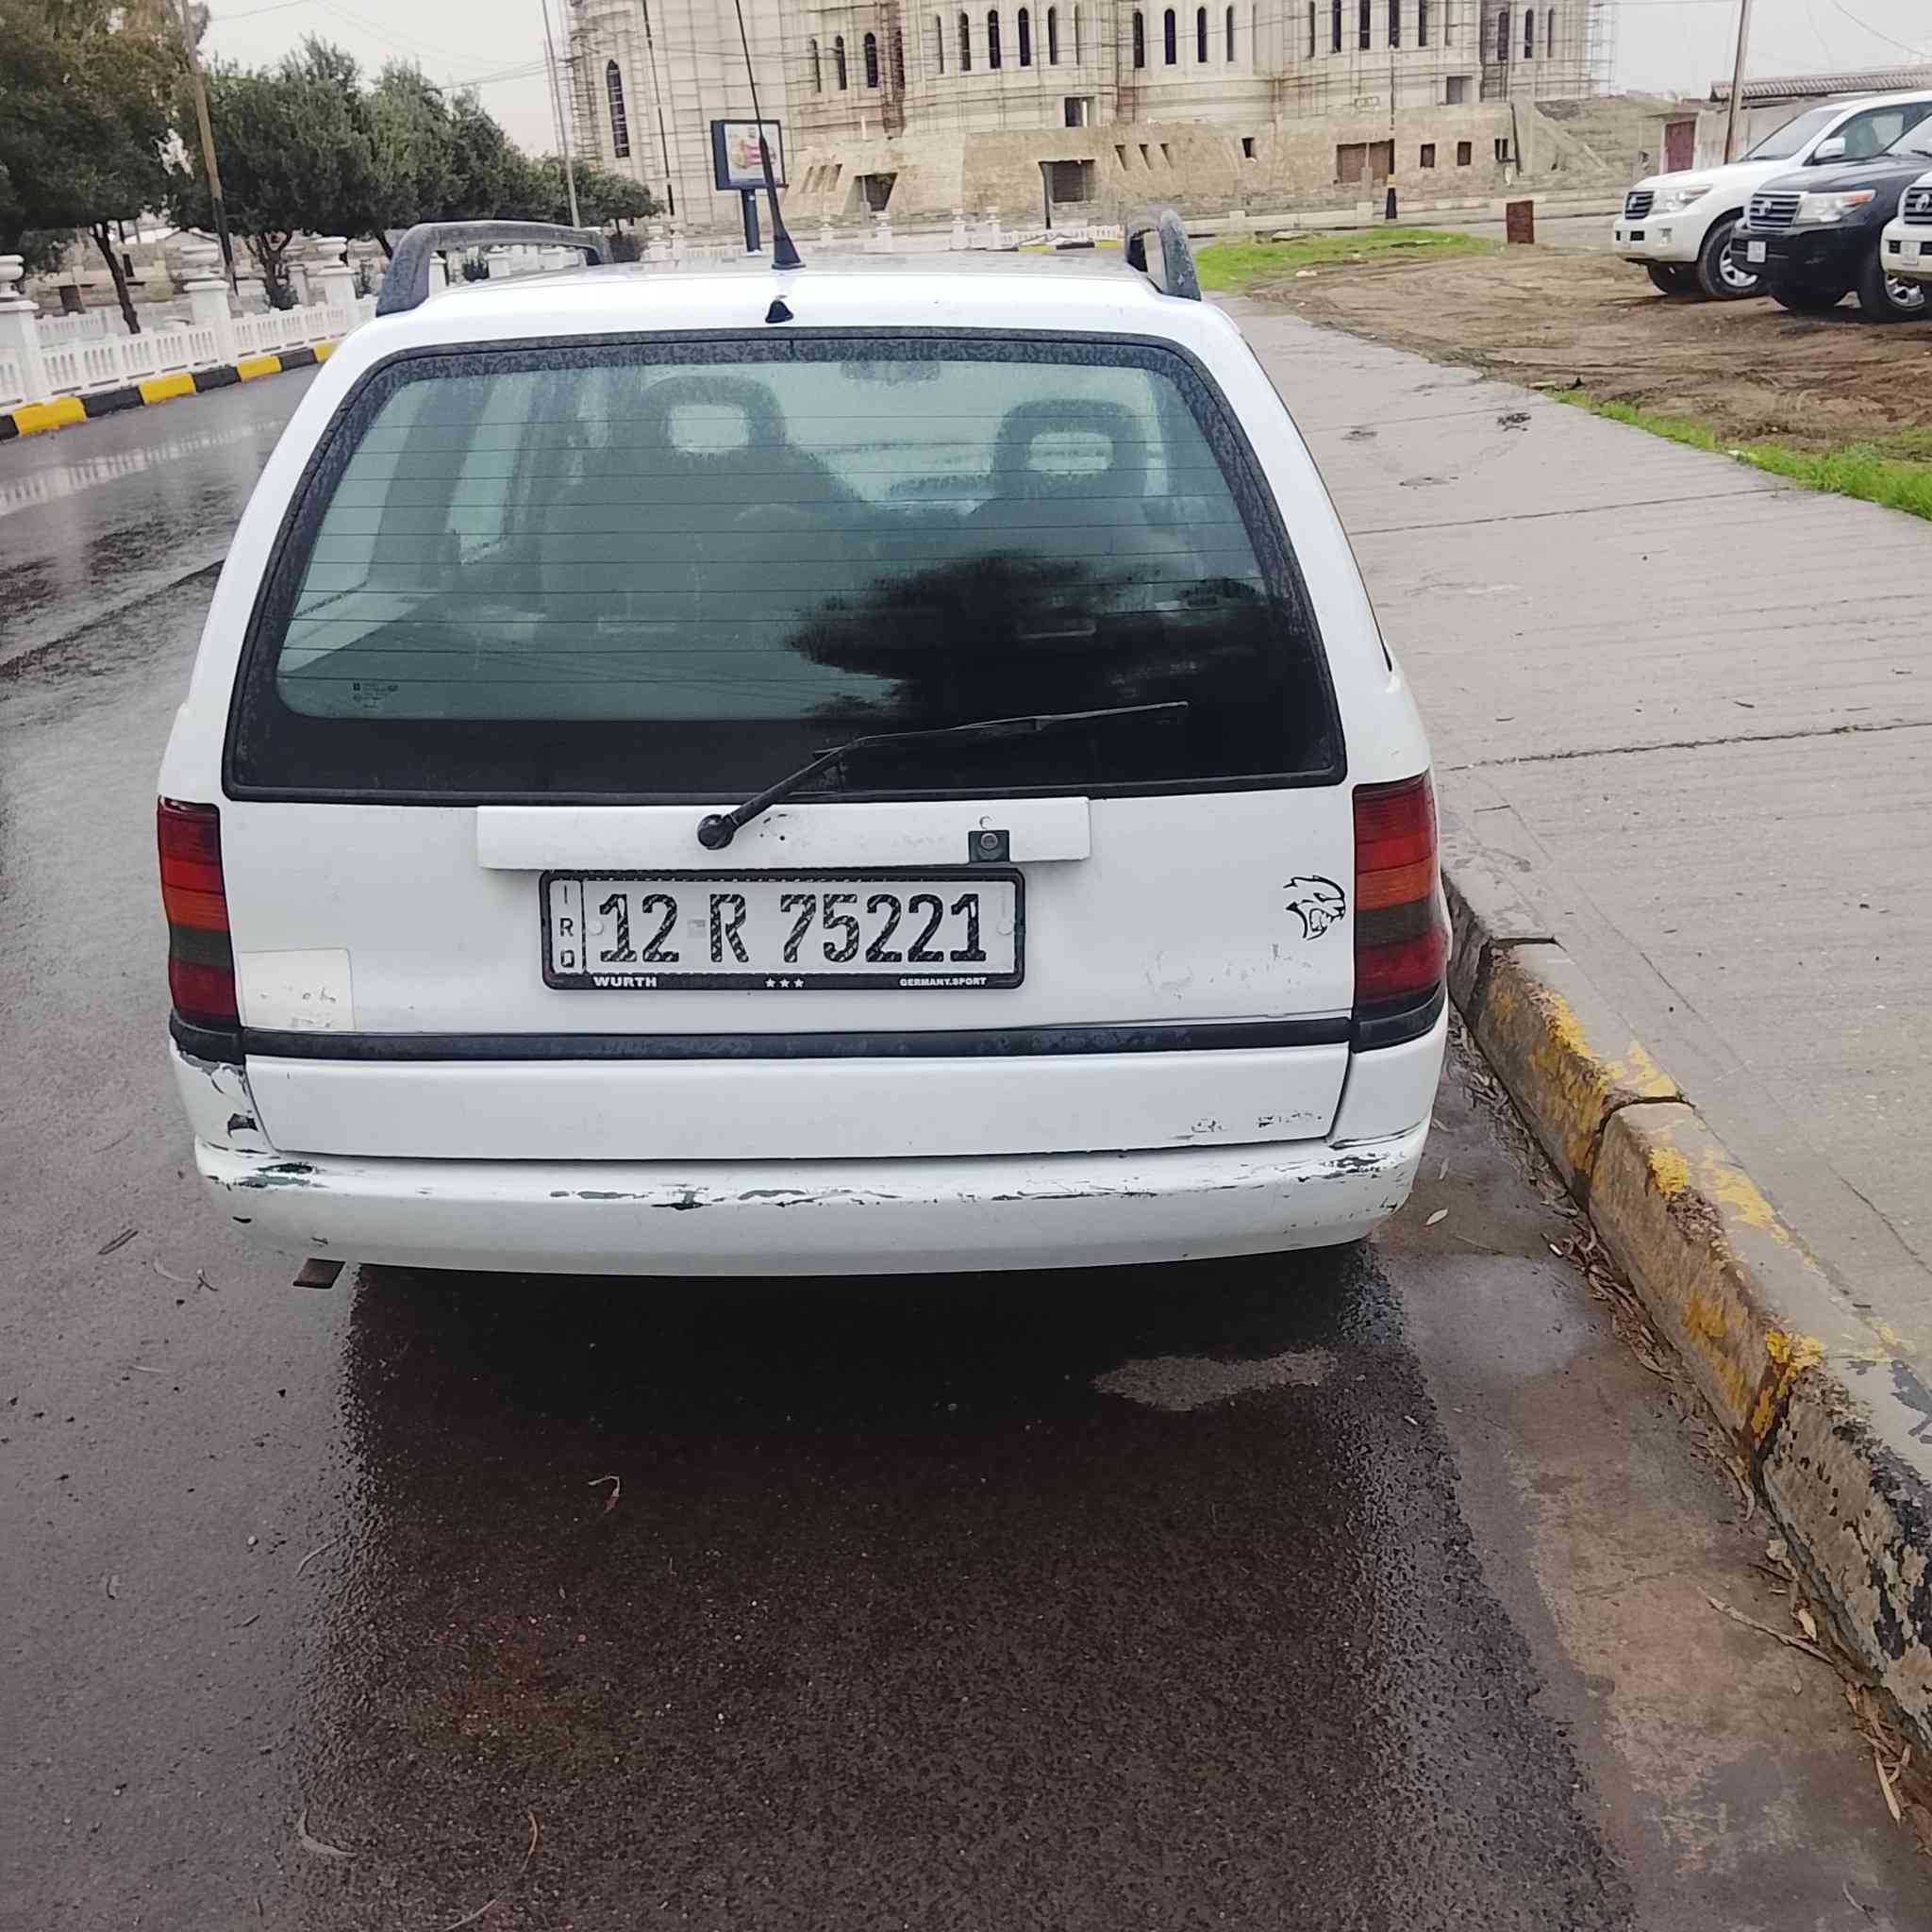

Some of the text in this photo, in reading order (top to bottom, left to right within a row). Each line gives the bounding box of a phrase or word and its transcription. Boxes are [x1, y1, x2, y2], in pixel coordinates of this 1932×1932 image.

[599, 893, 987, 962] 12 R 75221
[592, 976, 658, 988] WURTH
